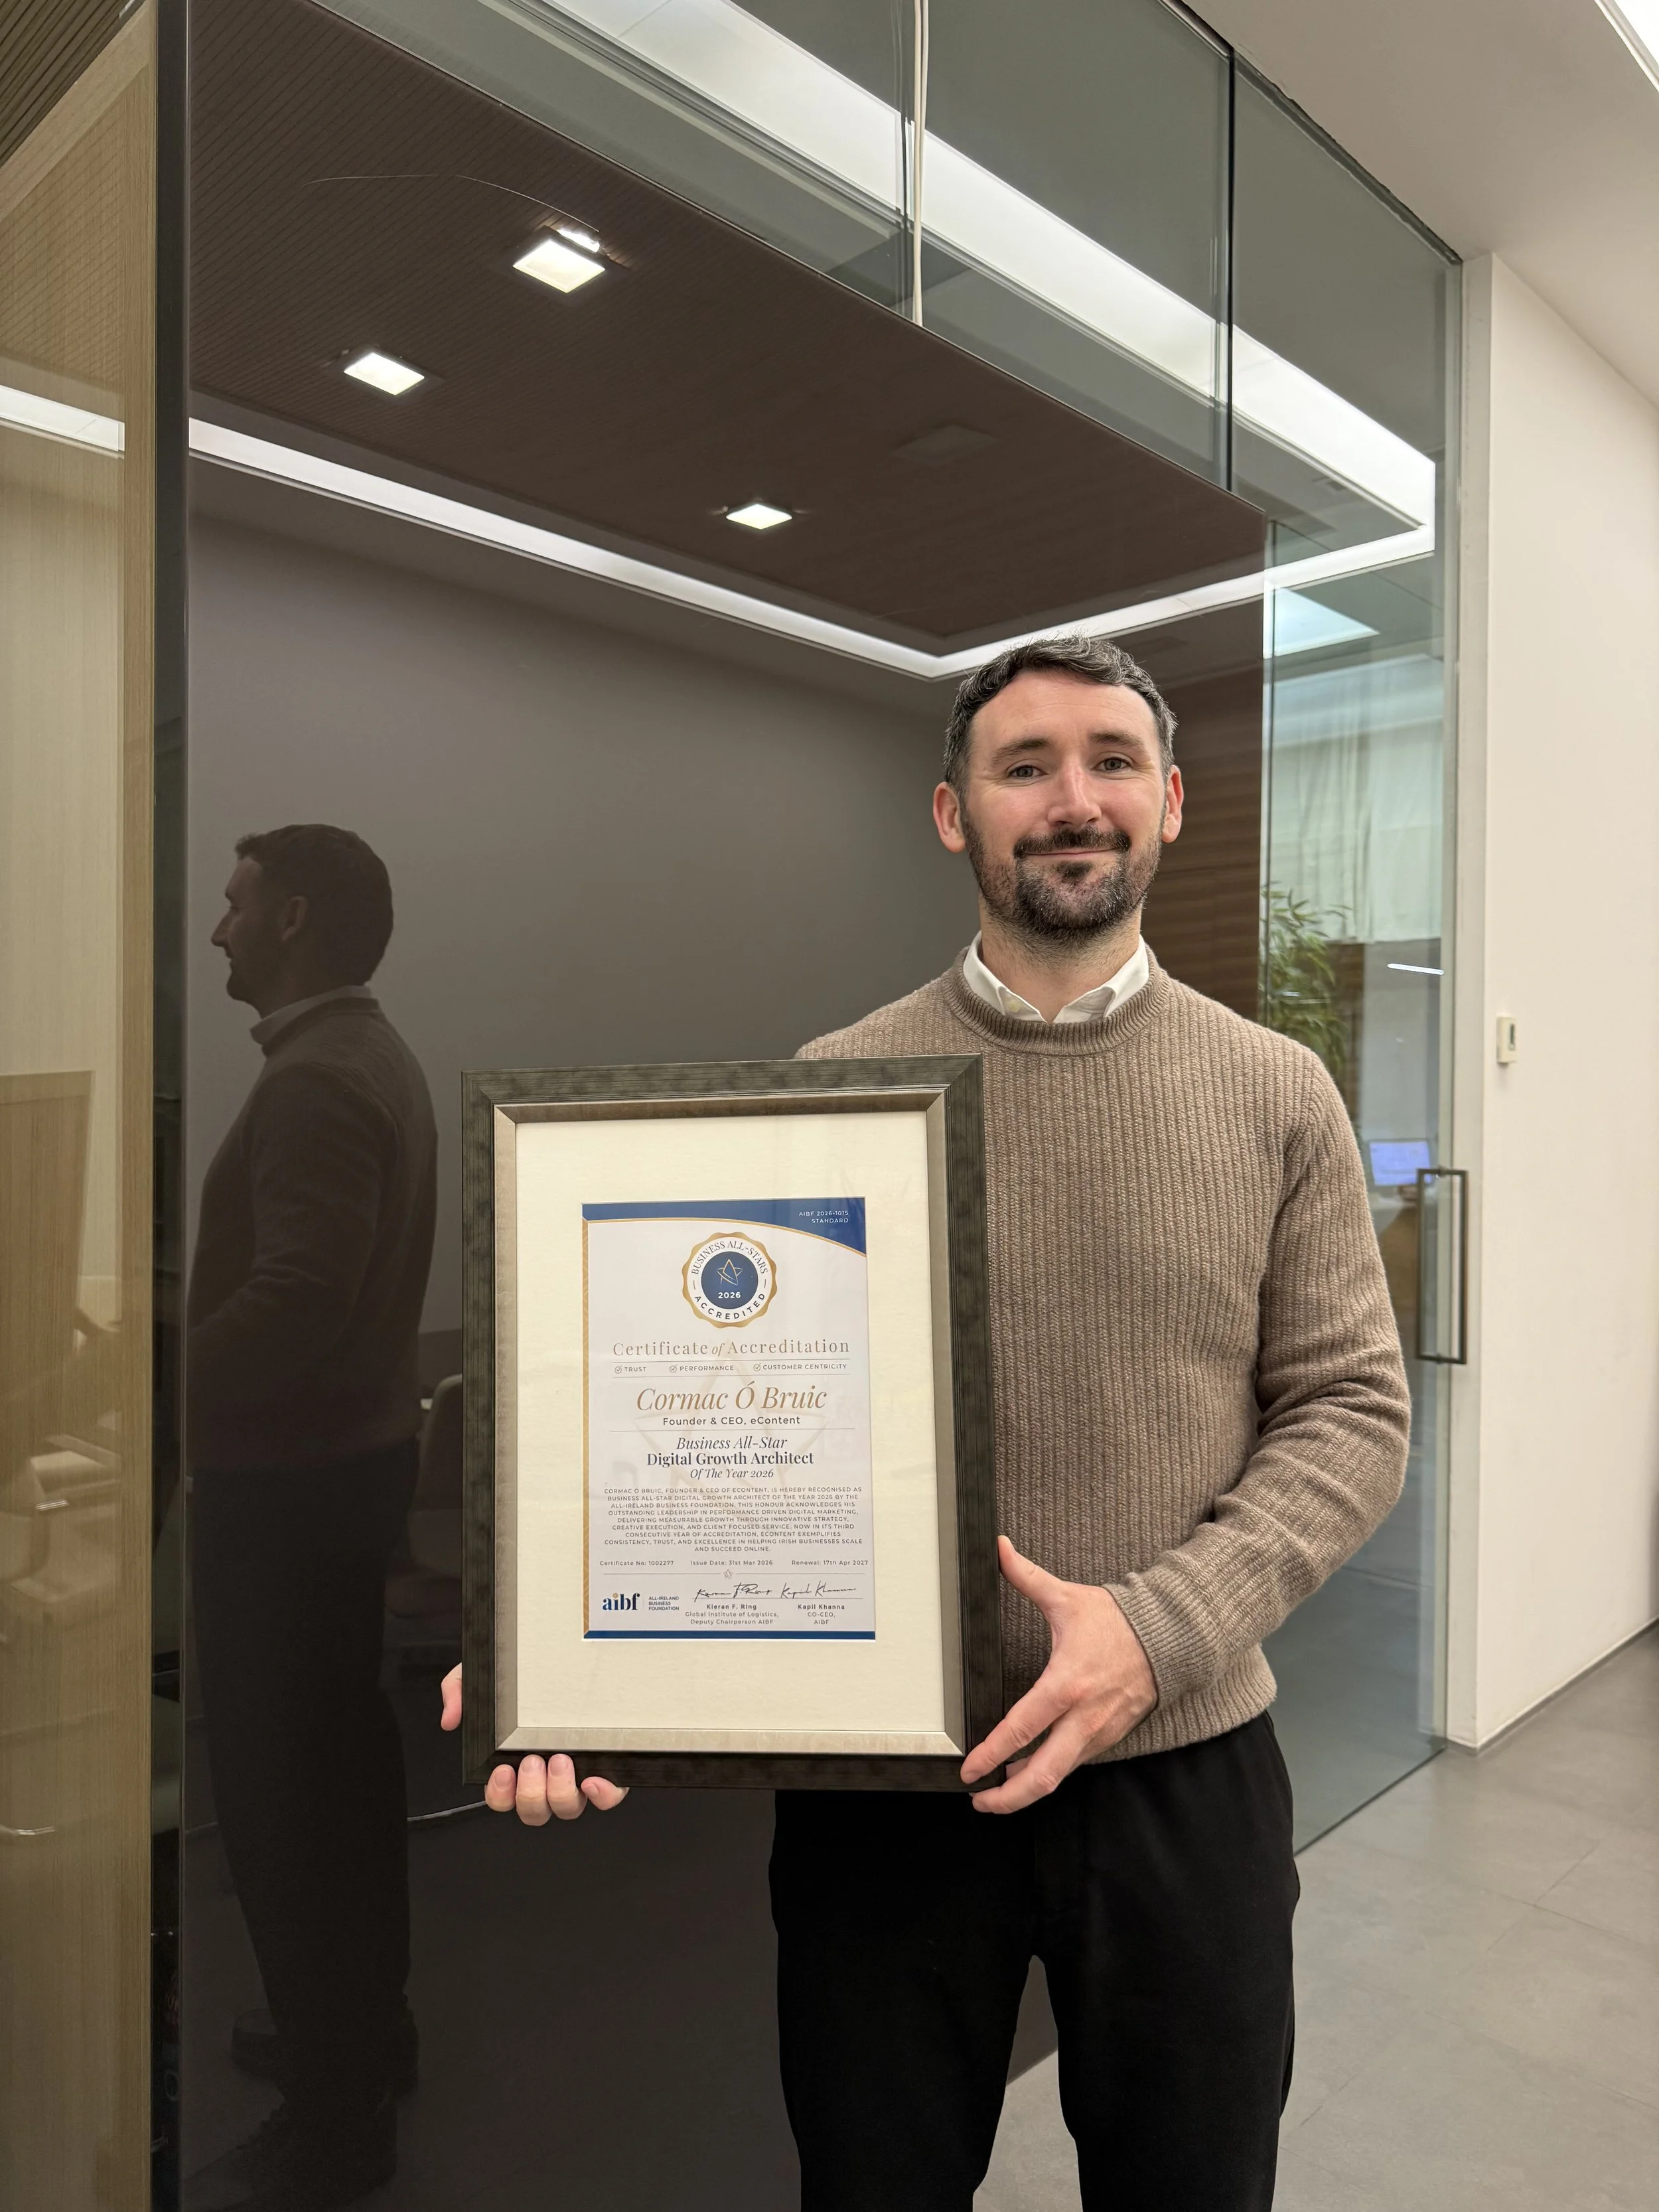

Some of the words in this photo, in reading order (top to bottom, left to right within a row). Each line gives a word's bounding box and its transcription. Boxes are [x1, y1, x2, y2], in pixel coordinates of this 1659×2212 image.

[691, 1240, 725, 1275] BUSINESS
[727, 1240, 768, 1274] ALL-STARS
[695, 1293, 765, 1319] ACCREDITED
[613, 1341, 708, 1356] Certificate
[711, 1343, 726, 1356] of
[727, 1339, 849, 1355] Accreditation
[637, 1388, 729, 1410] Cormac
[735, 1382, 755, 1409] Ó
[760, 1386, 828, 1408] Bruic
[676, 1437, 731, 1449] Business
[733, 1436, 788, 1449] All-Star
[648, 1453, 691, 1467] Digital
[696, 1452, 747, 1465] Growth
[751, 1451, 814, 1464] Architect
[690, 1468, 703, 1480] Of
[705, 1468, 723, 1478] The
[726, 1469, 749, 1478] Year
[751, 1469, 774, 1478] 2026
[603, 1592, 640, 1610] aibf
